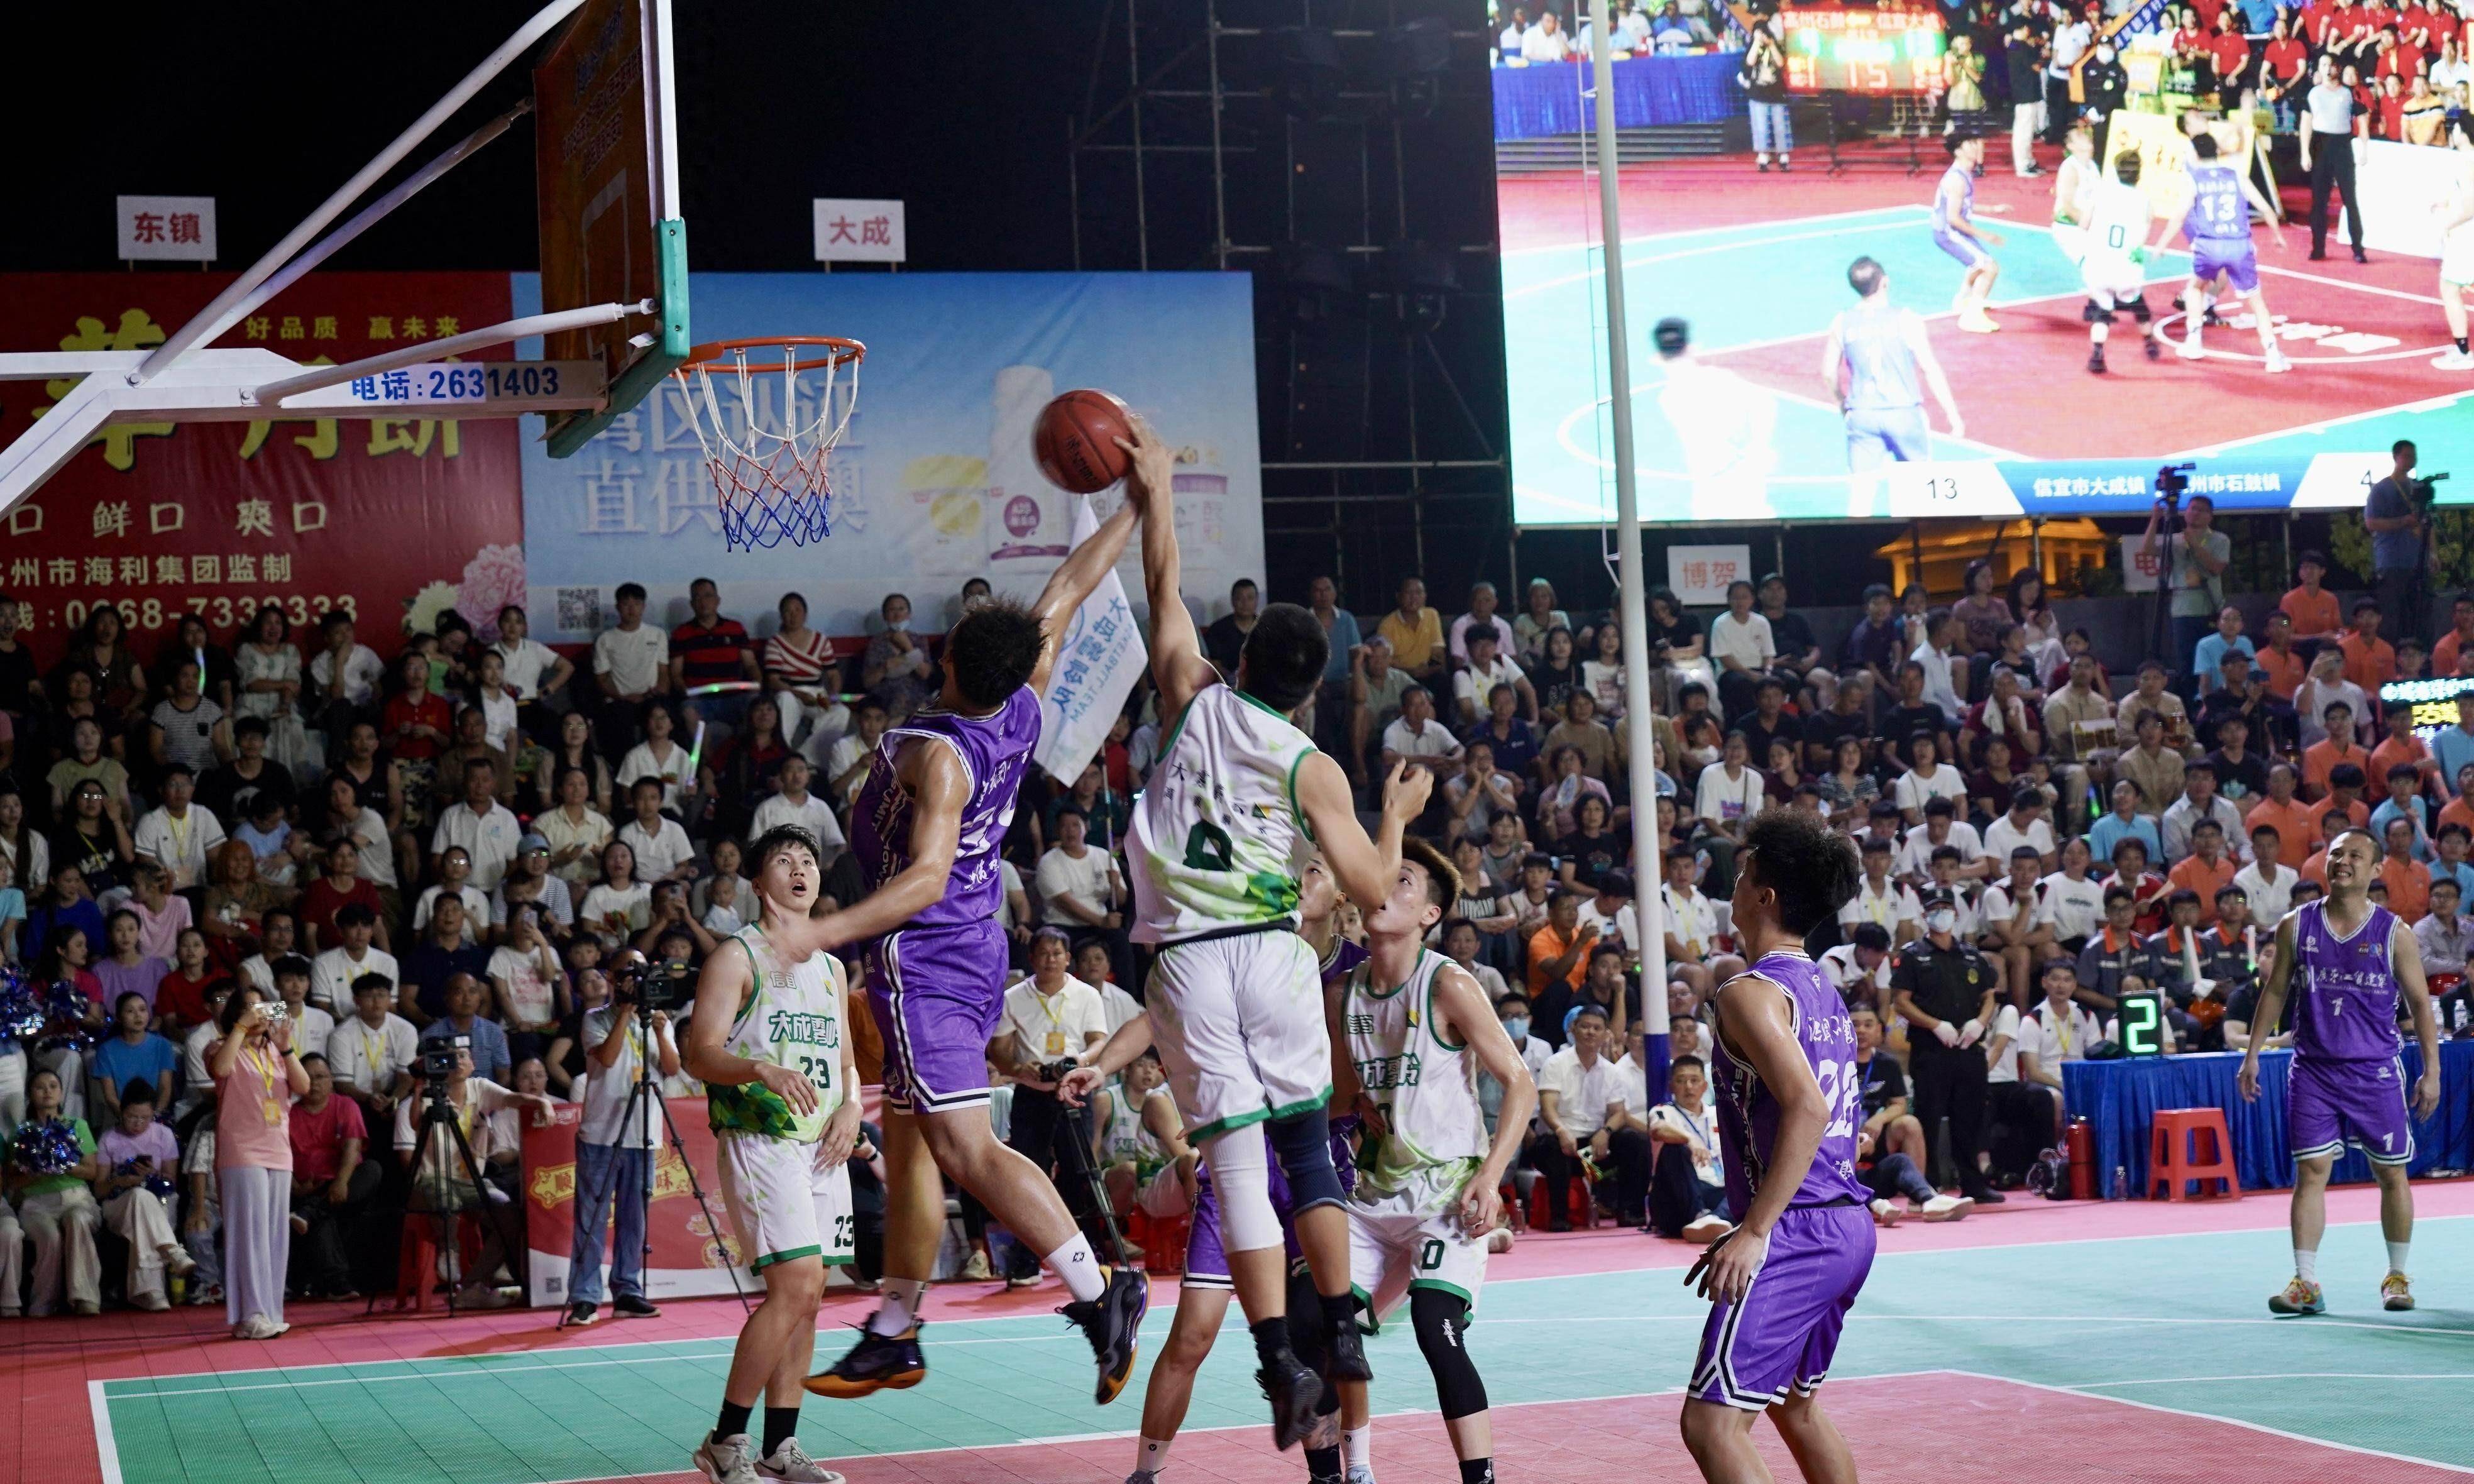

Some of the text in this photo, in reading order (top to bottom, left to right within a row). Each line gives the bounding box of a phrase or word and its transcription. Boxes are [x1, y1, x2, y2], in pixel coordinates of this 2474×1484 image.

[2202, 194, 2237, 222] 13
[134, 212, 201, 244] 东镇
[830, 215, 891, 246] 大成
[2109, 224, 2125, 248] 0
[245, 315, 460, 339] 好品质 赢未来
[1927, 478, 1957, 499] 13
[2184, 473, 2282, 494] 州市石鼓镇
[235, 498, 327, 537] 爽口
[0, 553, 292, 588] 州市海利集团监制
[1682, 559, 1736, 588] 博贺
[2331, 997, 2343, 1016] 1
[2125, 998, 2158, 1053] 2
[800, 1055, 830, 1089] 23
[2383, 1132, 2394, 1152] 1
[834, 1214, 854, 1248] 23
[1421, 1239, 1444, 1270] 0
